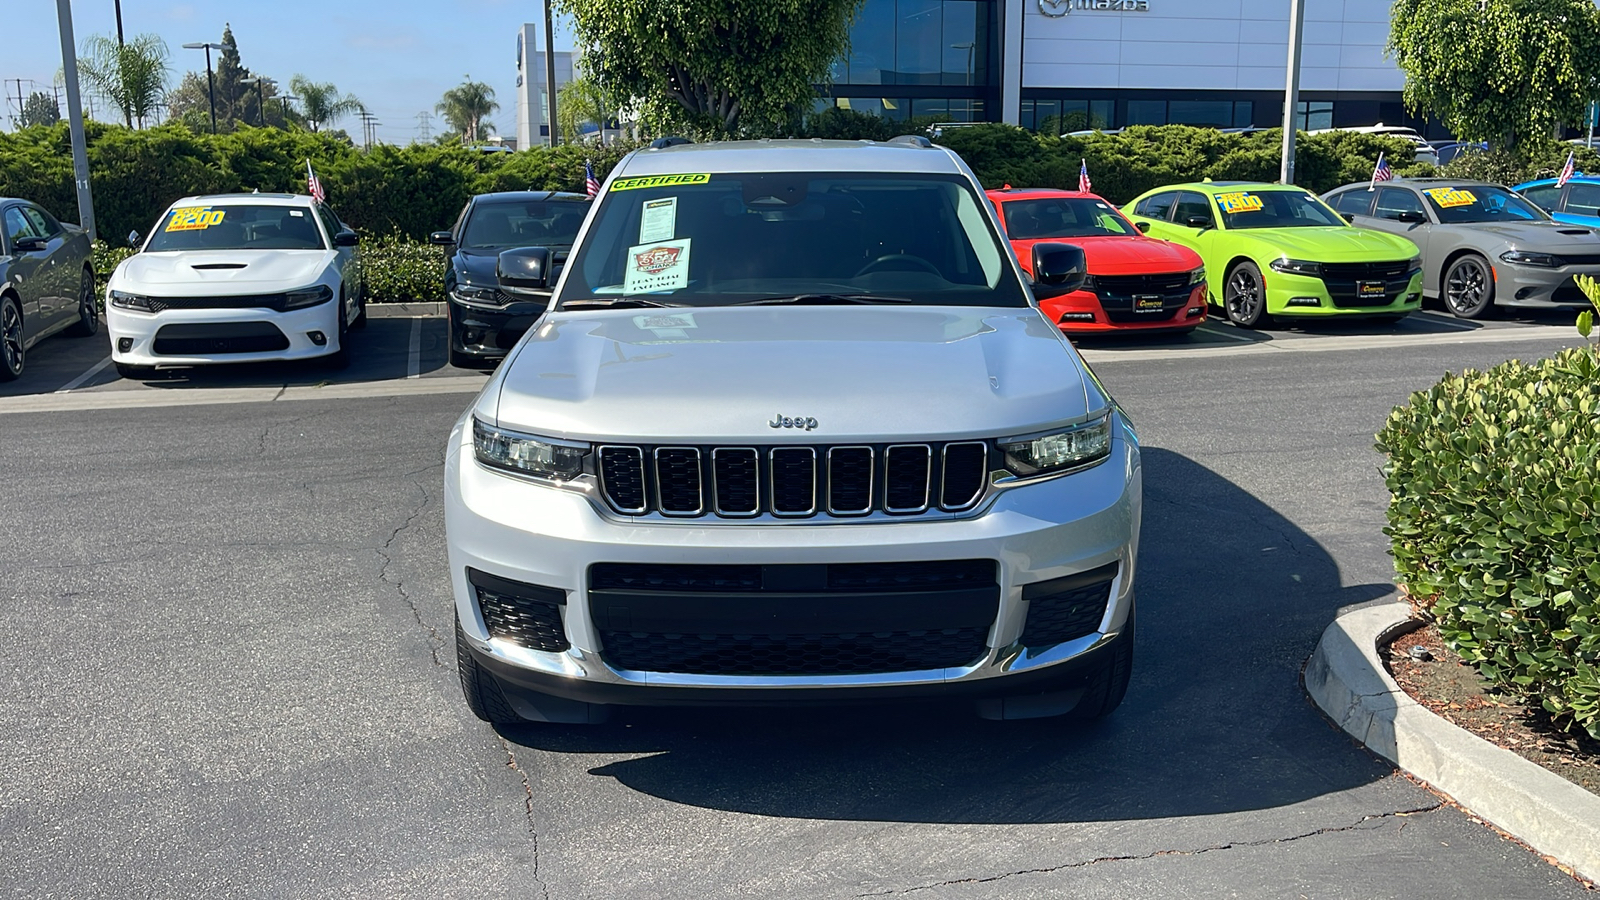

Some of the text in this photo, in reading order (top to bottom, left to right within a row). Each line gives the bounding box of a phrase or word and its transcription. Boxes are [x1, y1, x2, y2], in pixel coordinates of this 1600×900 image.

[1075, 0, 1150, 11] mazda
[76, 179, 88, 190] 11
[613, 174, 706, 189] CERTIFIED
[1217, 195, 1264, 211] 7900
[169, 210, 225, 226] 8200
[768, 413, 819, 432] Jeep
